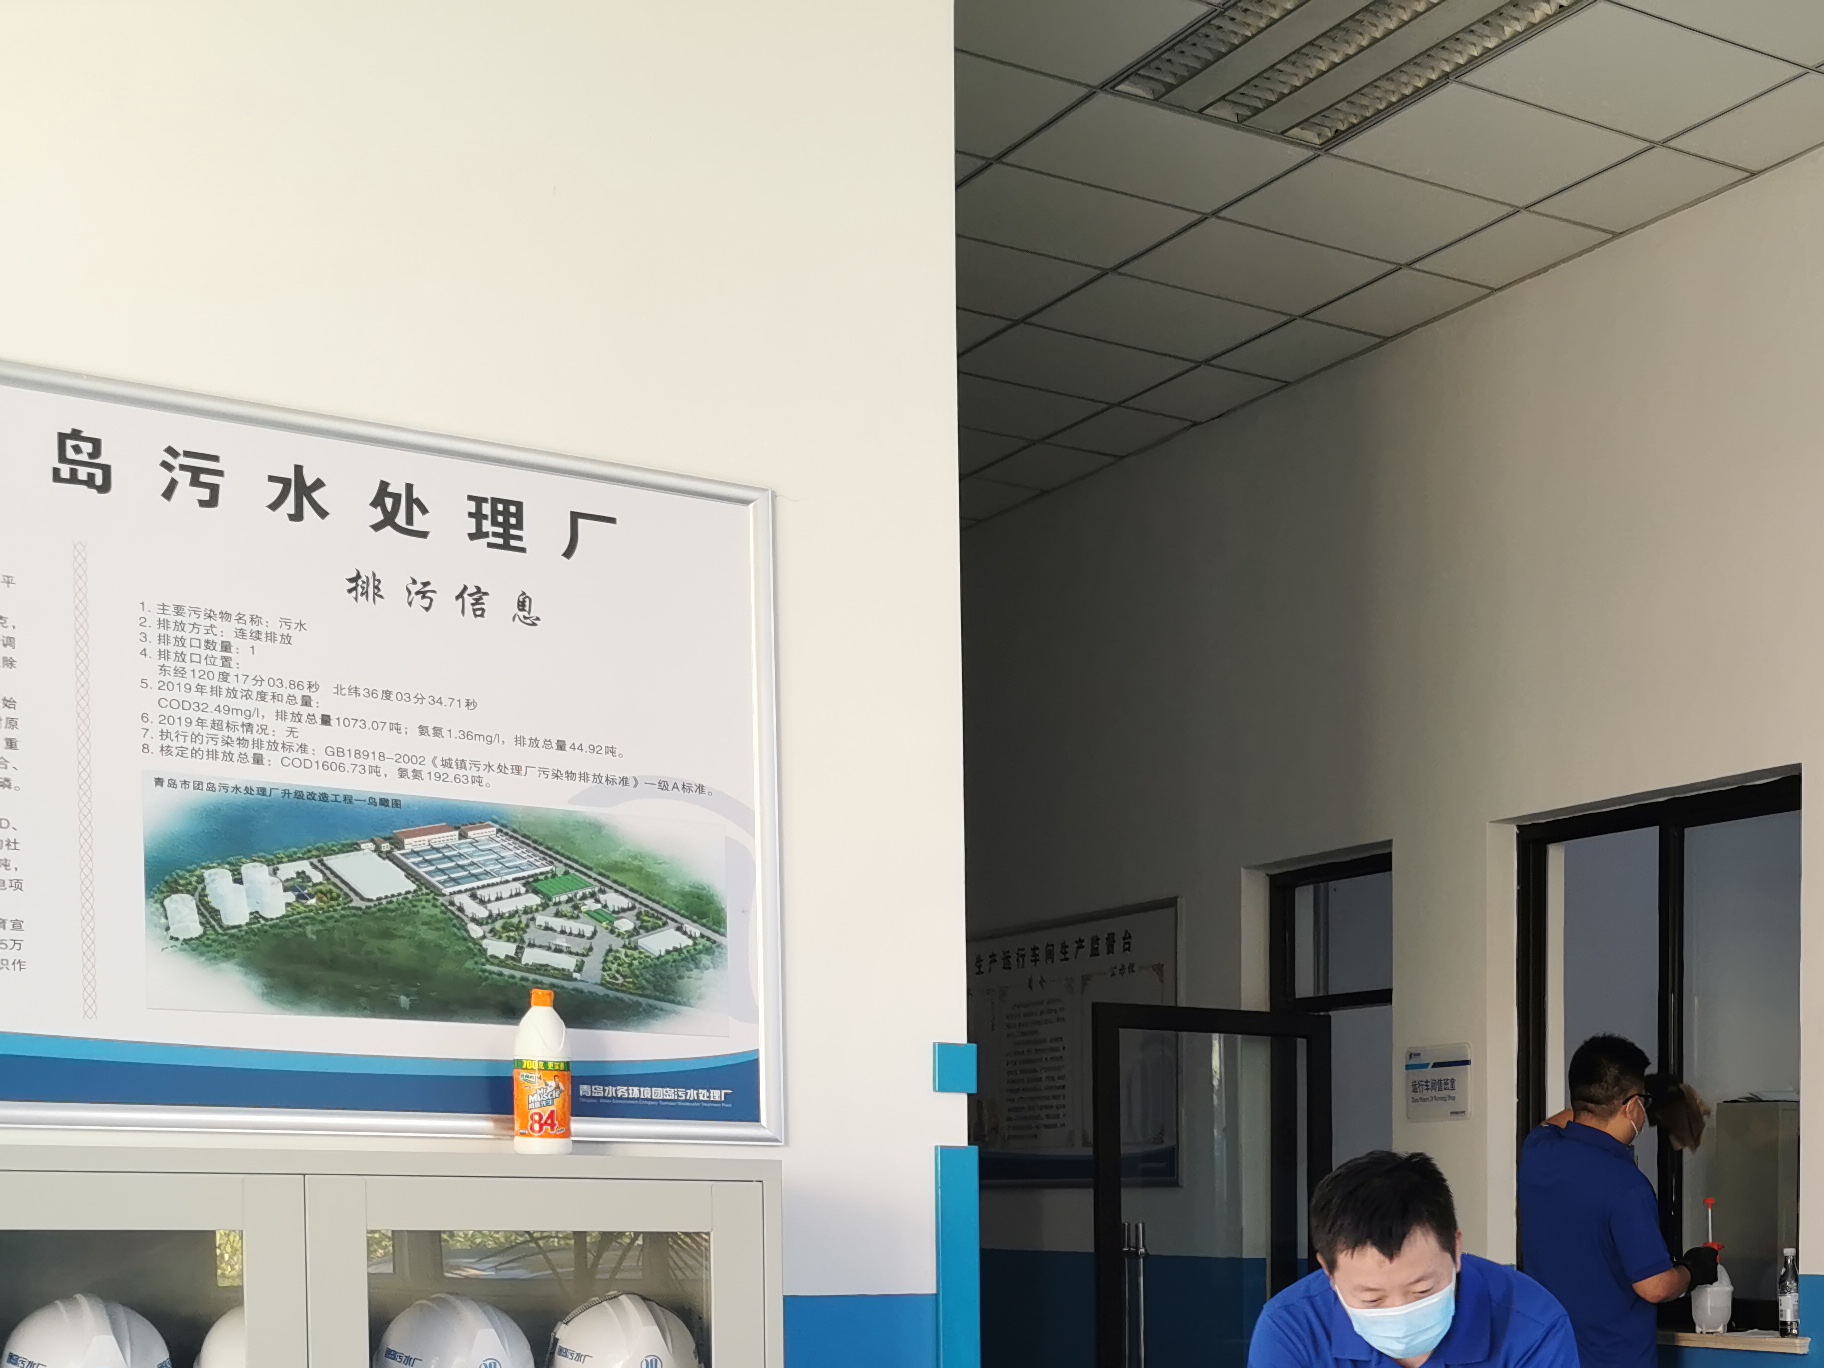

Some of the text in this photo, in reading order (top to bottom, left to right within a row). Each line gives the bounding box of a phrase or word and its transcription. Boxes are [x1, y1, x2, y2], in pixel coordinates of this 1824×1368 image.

[345, 567, 541, 628] 排污信息
[529, 1110, 557, 1134] 84
